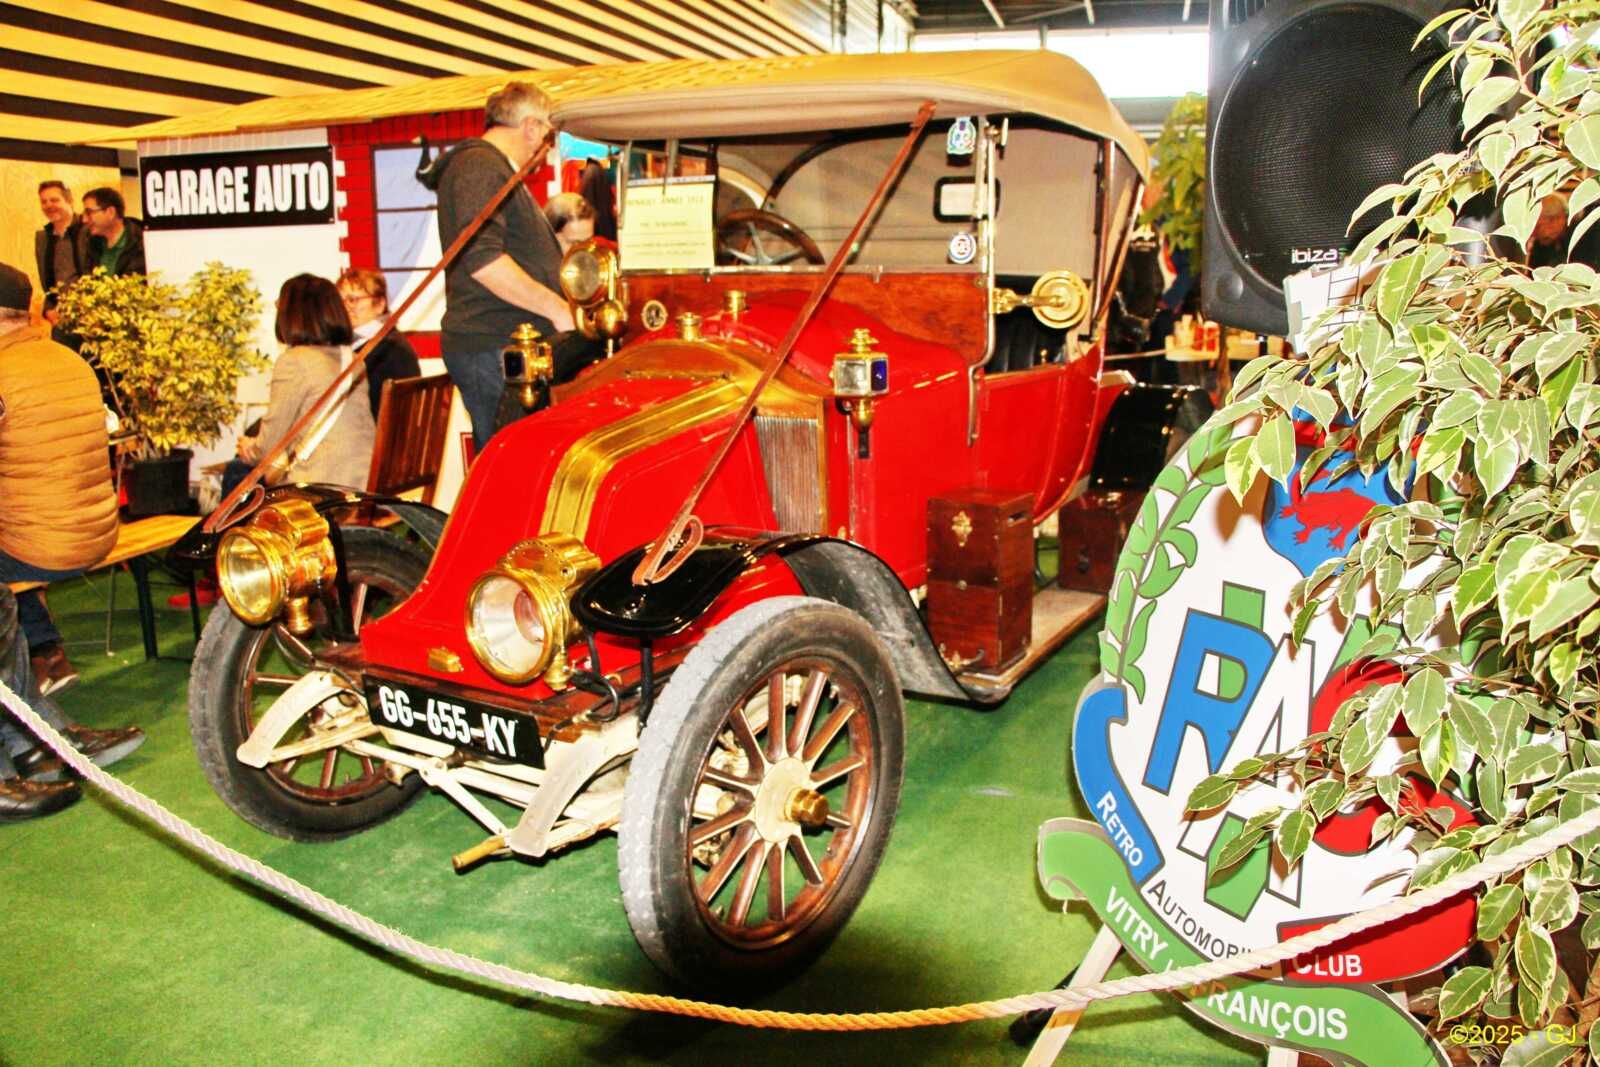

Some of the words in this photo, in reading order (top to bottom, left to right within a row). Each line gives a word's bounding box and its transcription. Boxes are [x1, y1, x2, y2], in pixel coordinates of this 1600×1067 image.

[146, 166, 250, 217] GARAGE
[254, 161, 329, 212] AUTO
[1291, 246, 1338, 264] ibiza
[379, 685, 517, 757] GG-655-KY
[1096, 791, 1144, 867] RETRO
[1106, 886, 1168, 960] VITRY
